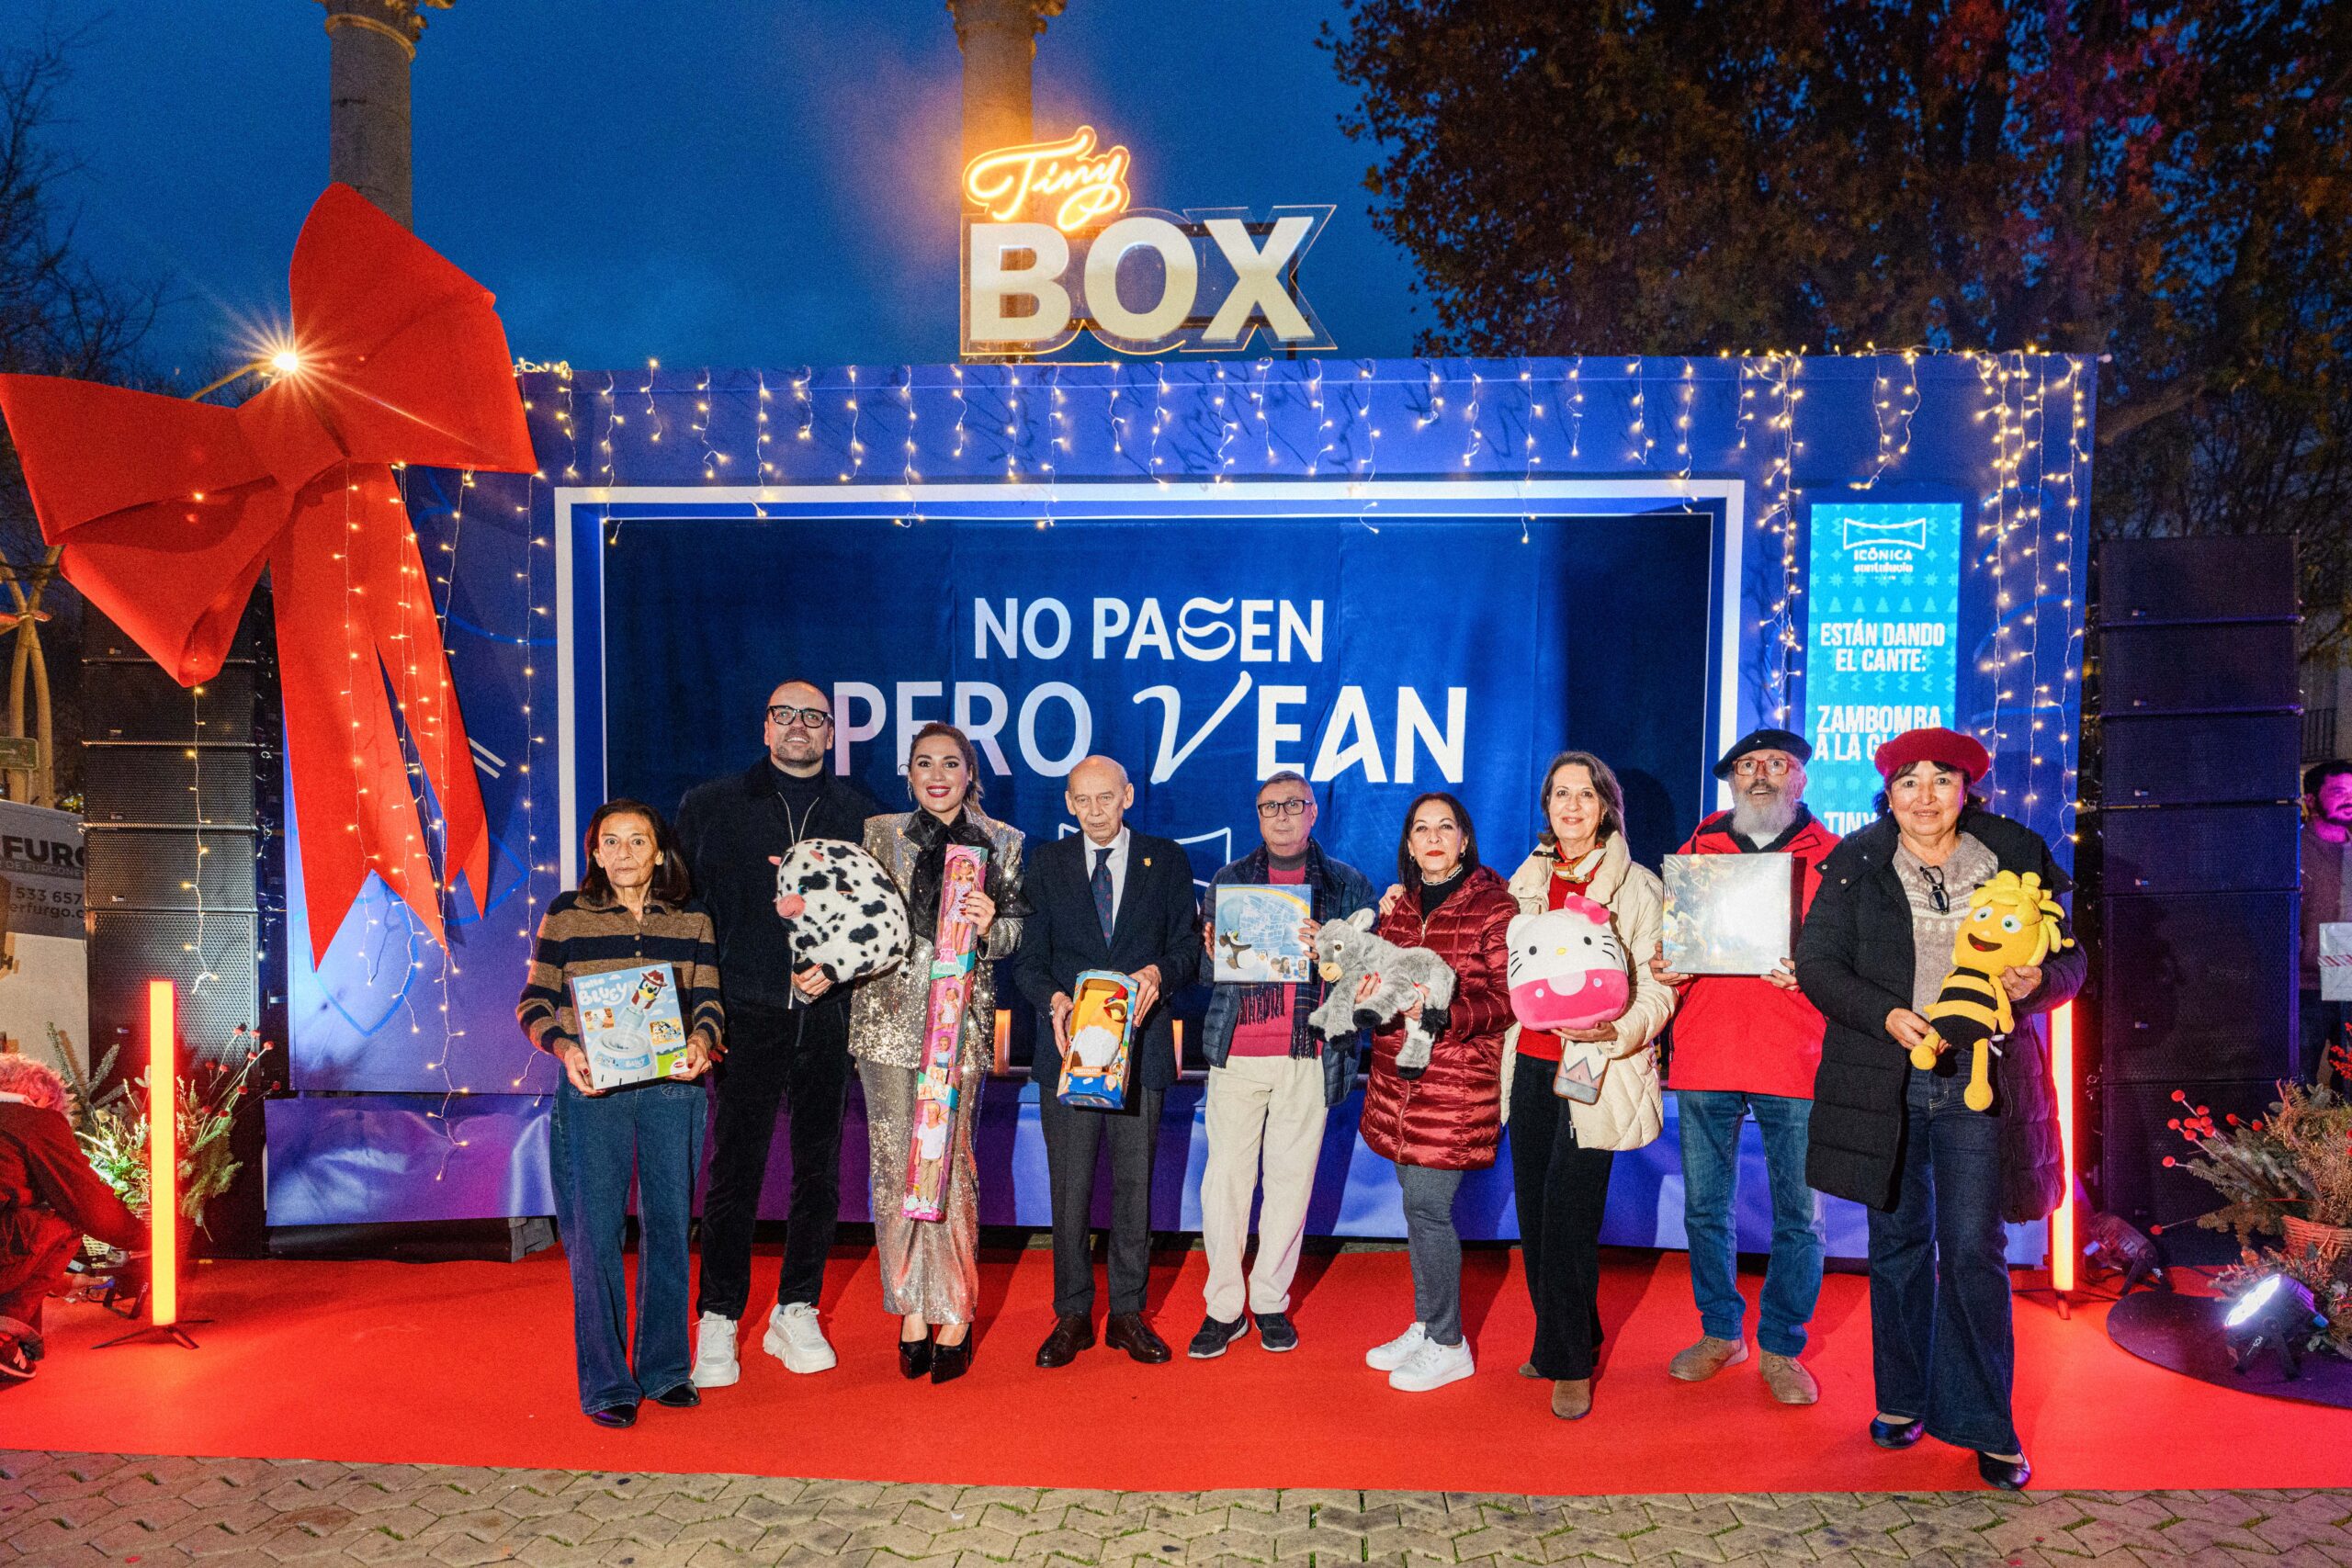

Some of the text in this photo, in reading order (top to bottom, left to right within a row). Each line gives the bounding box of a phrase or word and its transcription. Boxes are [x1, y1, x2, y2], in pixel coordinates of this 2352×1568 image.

[967, 132, 1123, 232] Tiny
[969, 216, 1316, 342] BOX
[974, 596, 1325, 663] NO PASEN
[1820, 618, 1945, 647] ESTÁN DANDO
[1836, 649, 1927, 672] EL CANTE:
[833, 671, 1468, 784] PERO VEAN
[1816, 705, 1941, 734] ZAMBOMBA
[1814, 733, 1829, 761] A
[1834, 734, 1861, 761] LA
[52, 891, 83, 905] 657
